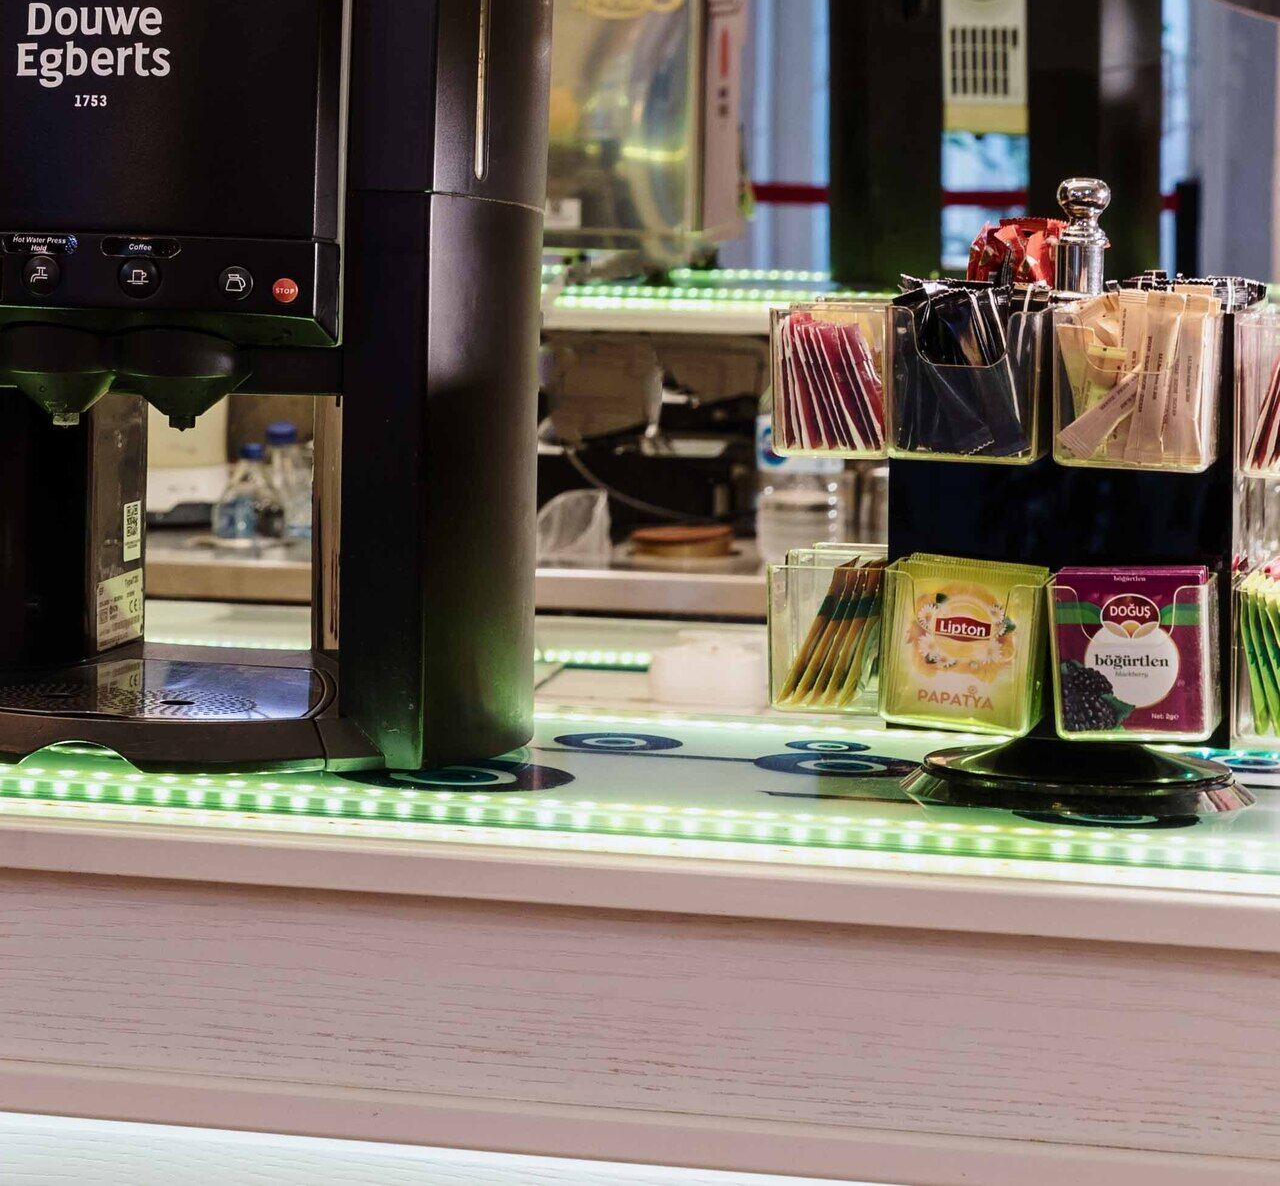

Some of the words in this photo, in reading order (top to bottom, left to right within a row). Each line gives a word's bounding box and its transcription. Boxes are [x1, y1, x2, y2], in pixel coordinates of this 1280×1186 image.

[27, 2, 163, 36] Douwe
[16, 41, 171, 88] Egberts
[74, 94, 108, 107] 1753
[26, 236, 45, 244] Water
[46, 237, 66, 245] Press
[30, 244, 48, 252] Hold
[128, 243, 152, 251] Coffee
[275, 287, 295, 295] STOP
[1109, 603, 1151, 618] DOĞUŞ
[940, 620, 986, 637] Lipton
[1094, 654, 1169, 669] böğürtlen
[917, 688, 994, 711] PAPATYA
